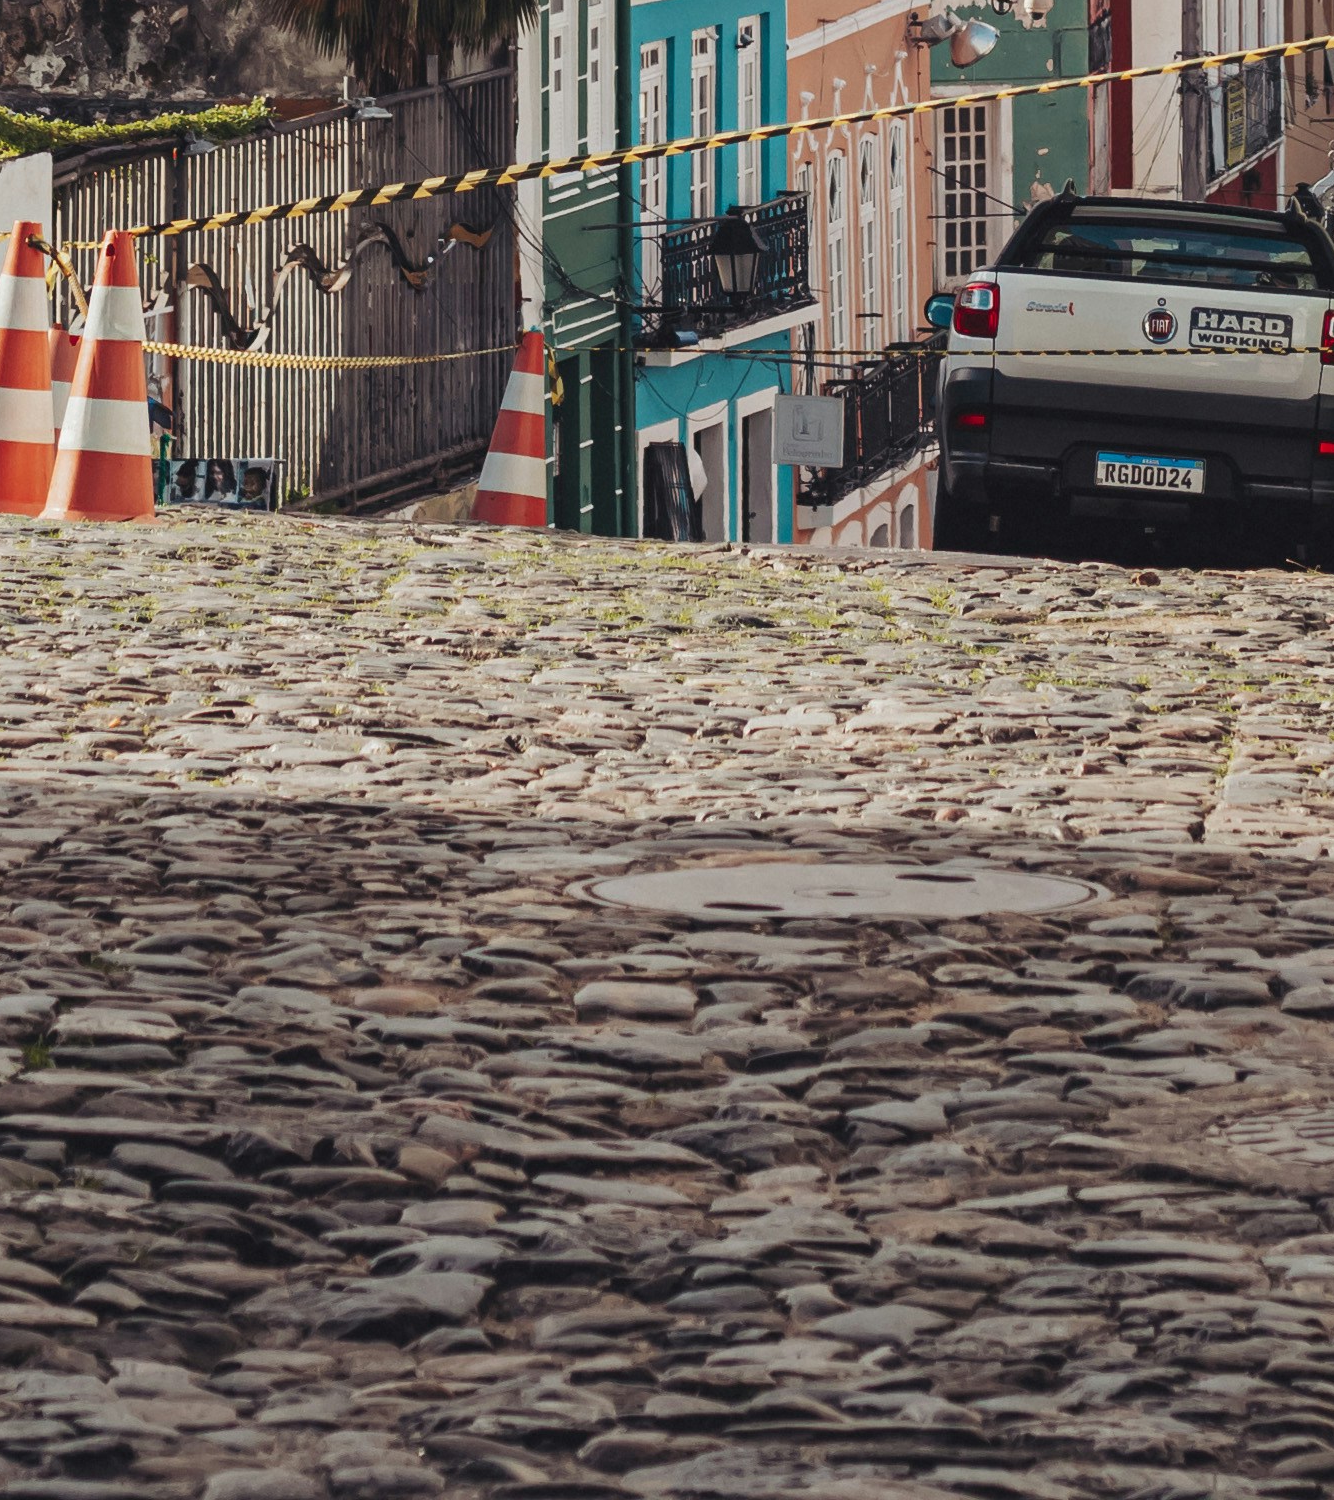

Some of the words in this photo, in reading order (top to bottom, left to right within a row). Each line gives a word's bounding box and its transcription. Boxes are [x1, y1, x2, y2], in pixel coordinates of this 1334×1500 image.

[1151, 318, 1171, 334] FIAT
[1197, 311, 1286, 335] HARD
[1197, 332, 1284, 349] WORKING
